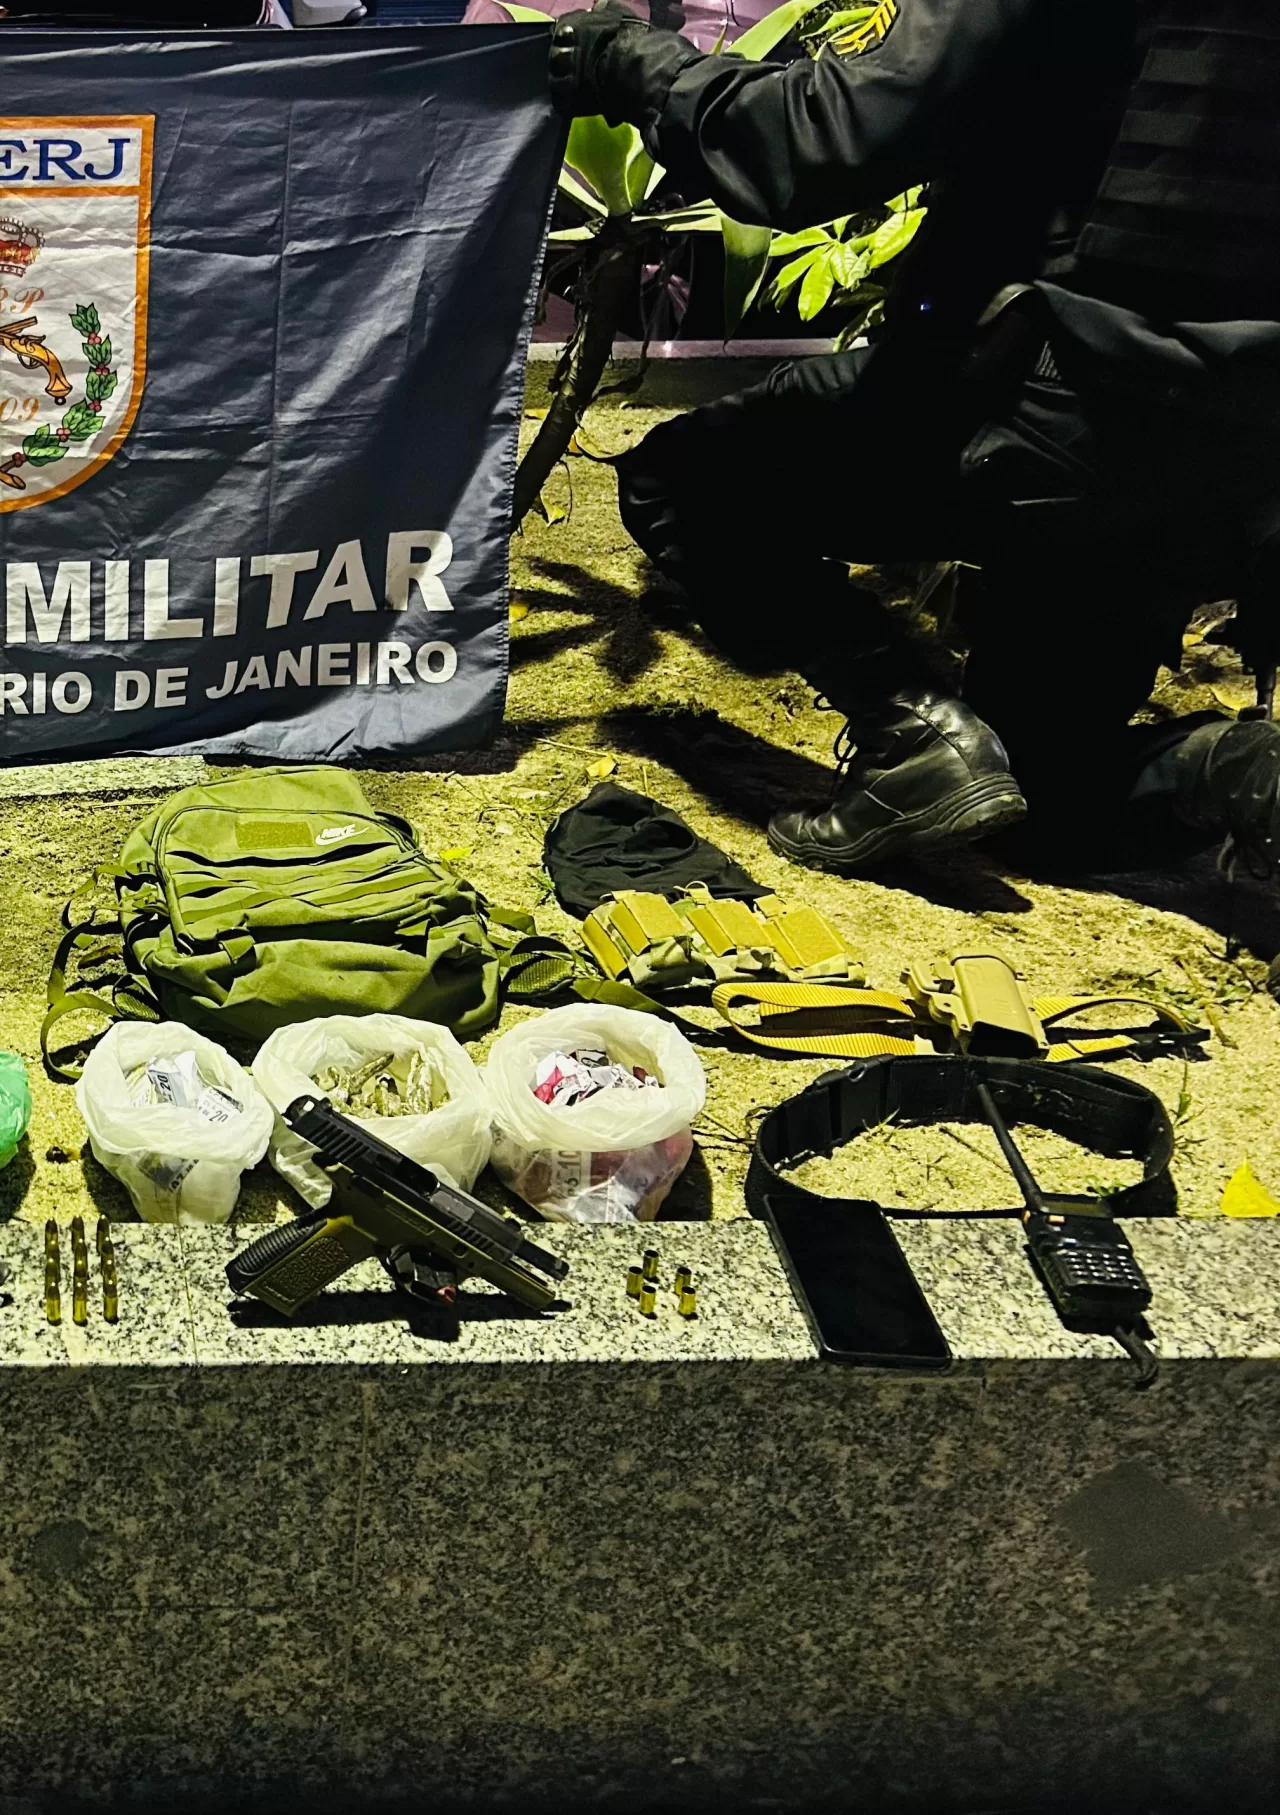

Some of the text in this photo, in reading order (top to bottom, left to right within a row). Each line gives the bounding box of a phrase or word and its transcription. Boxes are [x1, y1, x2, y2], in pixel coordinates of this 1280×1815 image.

[5, 530, 455, 644] MILITAR
[114, 667, 189, 712] DE
[205, 641, 458, 701] JANEIRO
